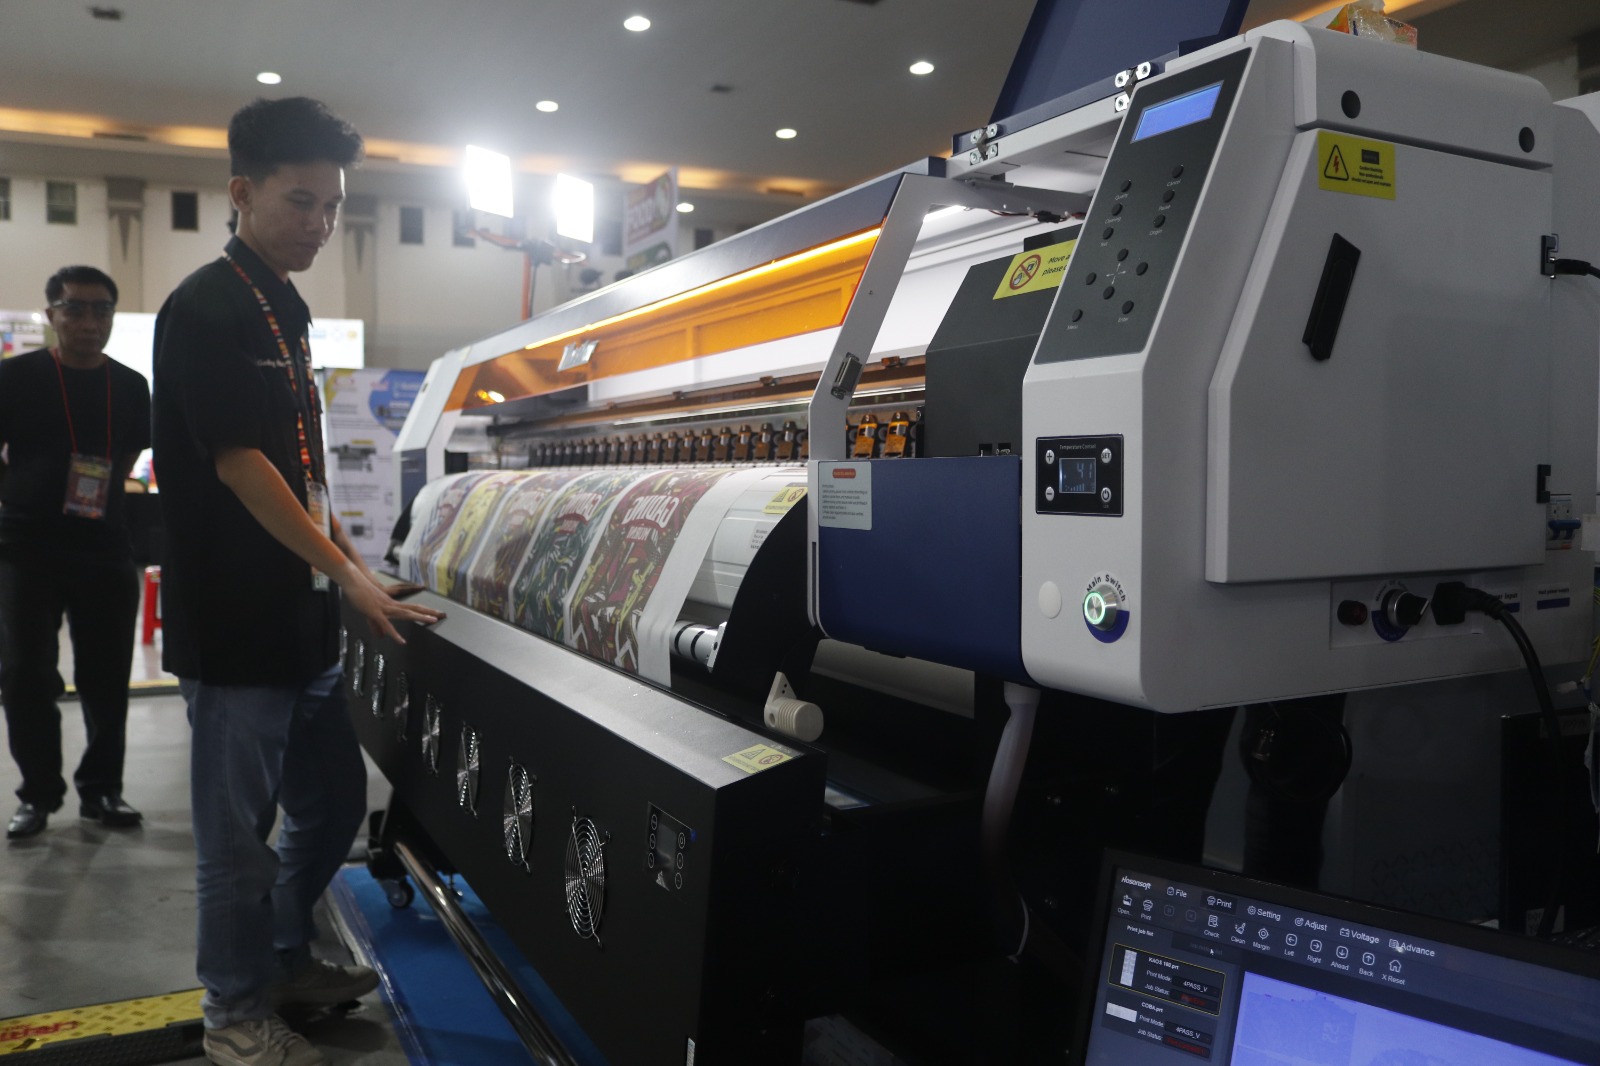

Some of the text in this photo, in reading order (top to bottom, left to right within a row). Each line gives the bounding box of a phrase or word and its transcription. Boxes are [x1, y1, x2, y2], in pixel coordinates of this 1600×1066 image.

[1048, 256, 1065, 265] Move
[1041, 266, 1063, 277] please
[1101, 452, 1111, 460] SET
[1086, 573, 1126, 602] Main Switch
[1175, 888, 1188, 898] File
[1216, 899, 1233, 909] Print
[1140, 912, 1152, 921] Print
[1256, 908, 1281, 922] Setting
[1126, 924, 1138, 934] Print
[1304, 919, 1328, 932] Adjust
[1230, 935, 1246, 945] Clean
[1350, 930, 1380, 944] Voltage
[1252, 941, 1271, 952] Margin
[1400, 942, 1436, 957] Advance
[1284, 948, 1295, 957] Left
[1306, 954, 1322, 964] Right
[1330, 961, 1350, 971] Ahead
[1146, 969, 1158, 979] Print
[1358, 967, 1374, 977] Back
[1387, 975, 1406, 986] Reset
[1144, 983, 1153, 991] Job
[1182, 980, 1209, 993] 4PASS_V
[1138, 1014, 1151, 1024] Print
[1137, 1028, 1146, 1036] Job
[1175, 1026, 1201, 1040] 4PASS_V
